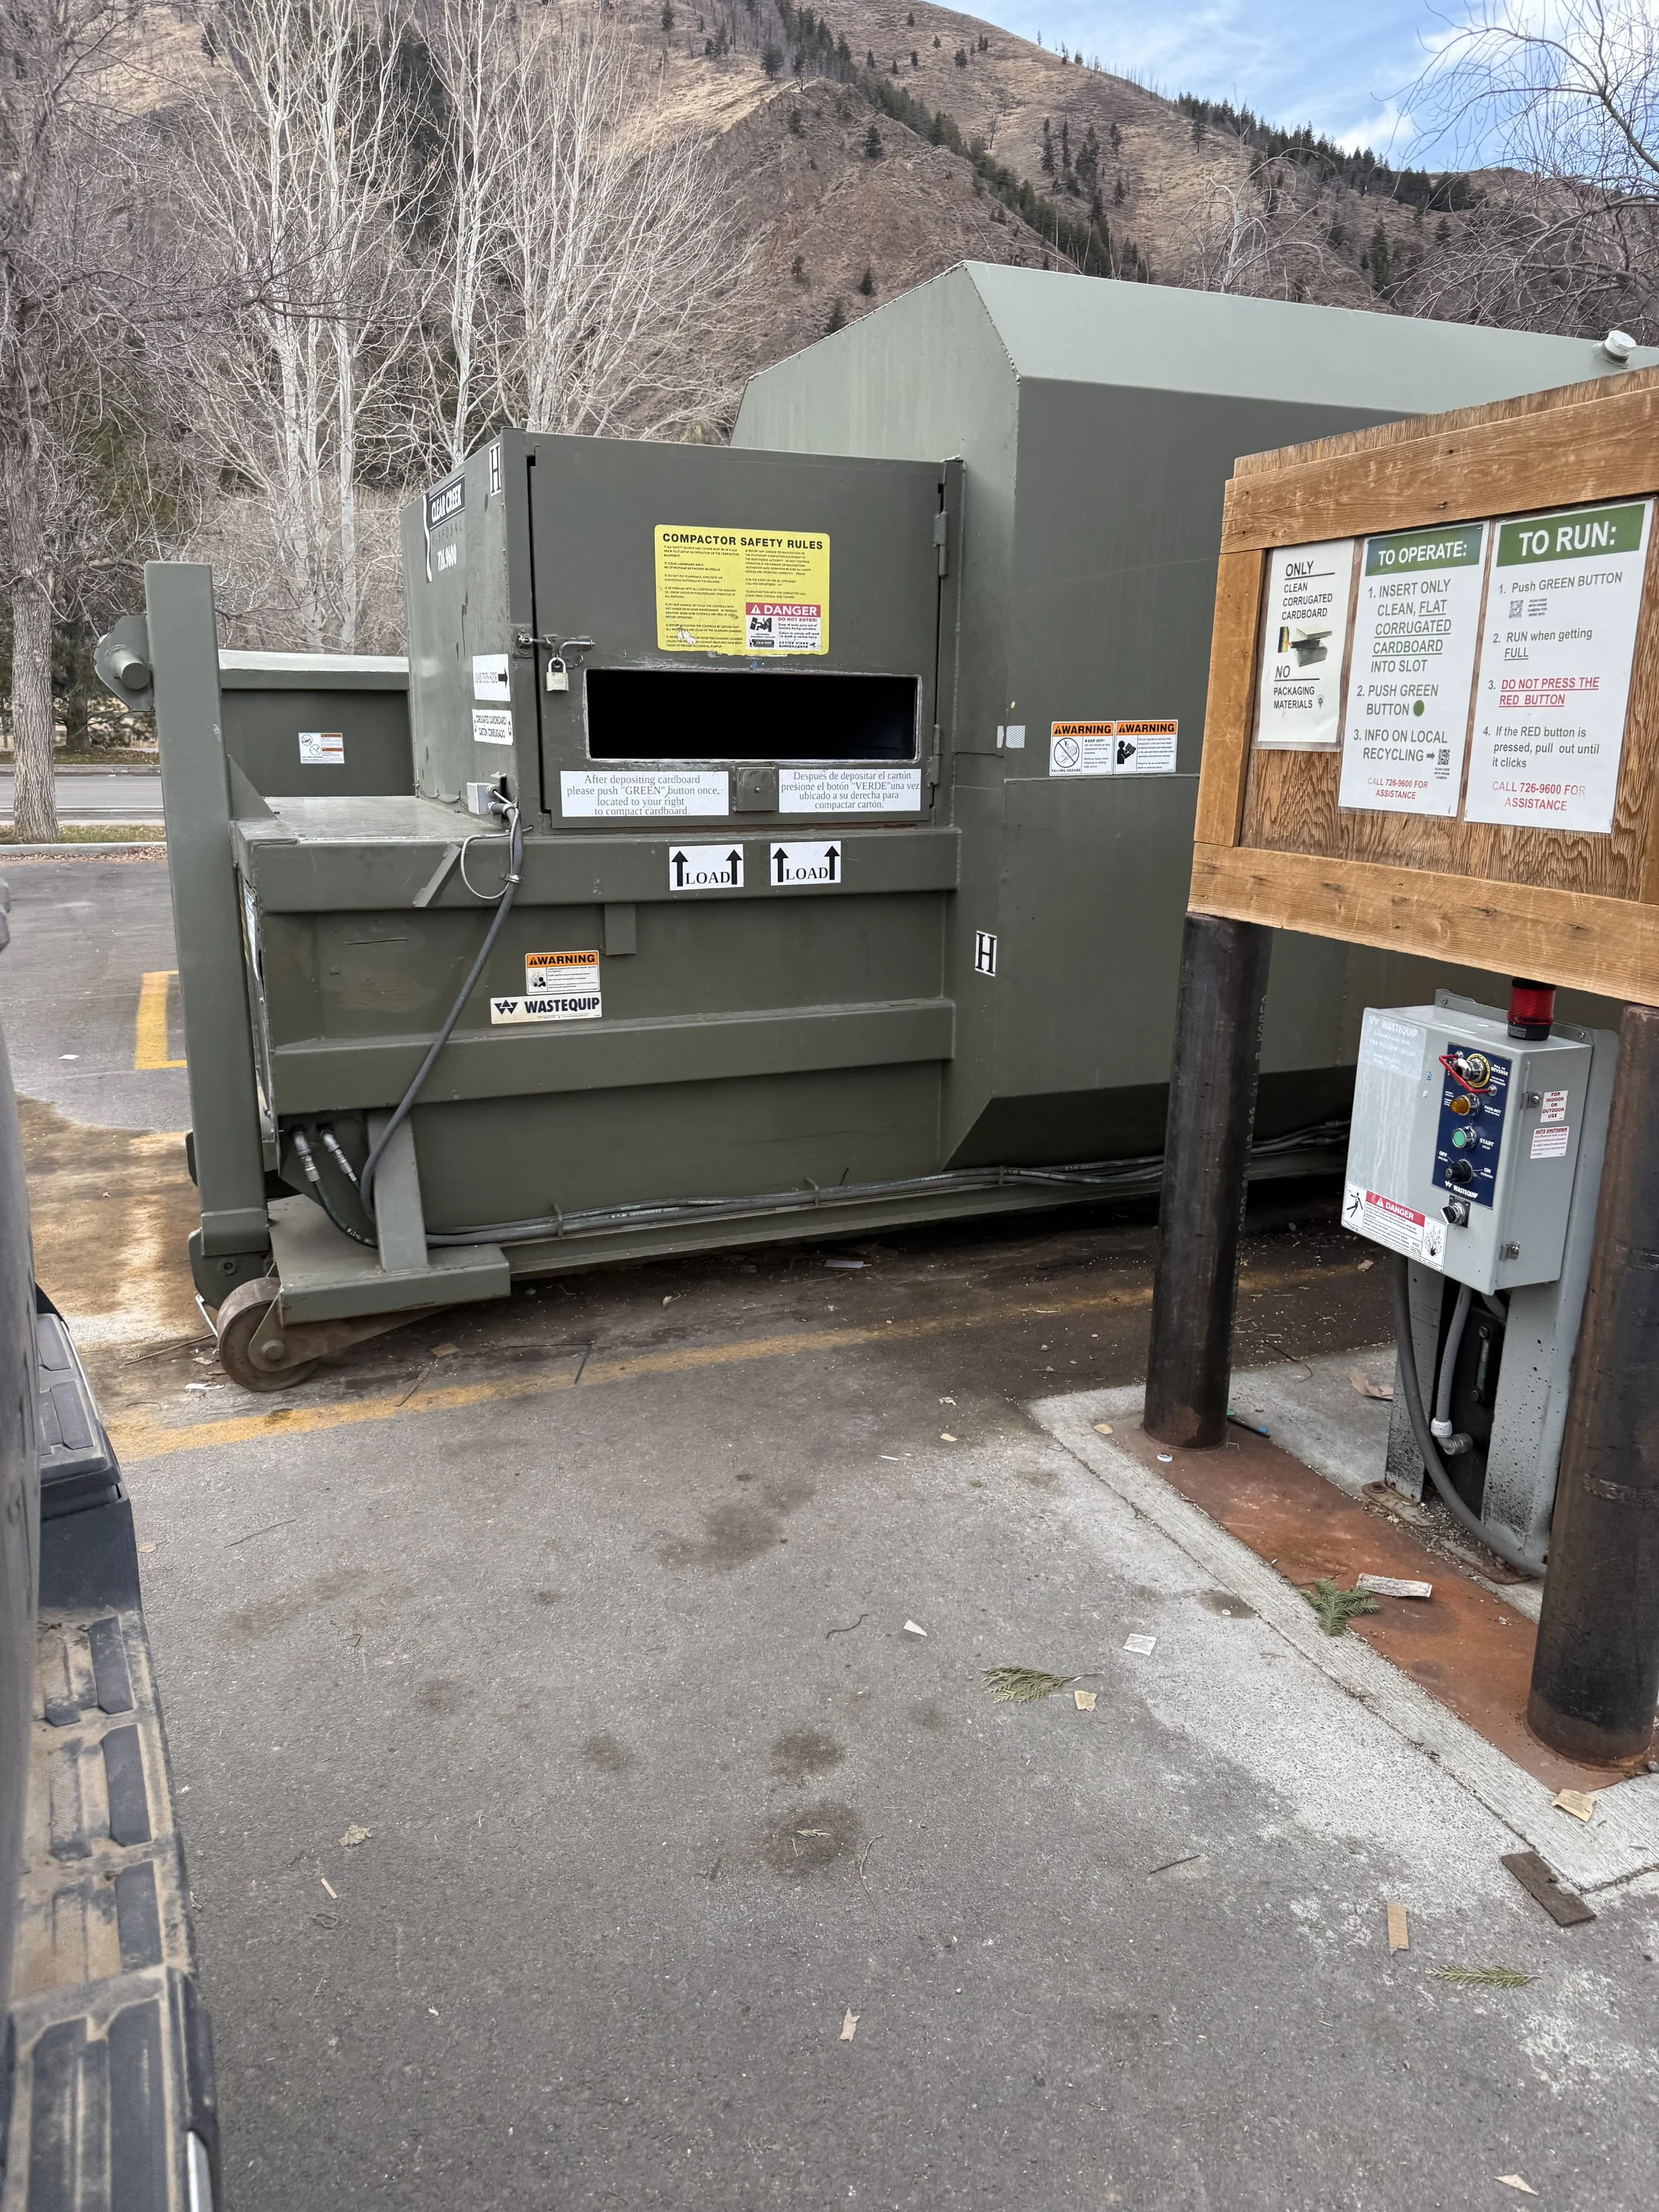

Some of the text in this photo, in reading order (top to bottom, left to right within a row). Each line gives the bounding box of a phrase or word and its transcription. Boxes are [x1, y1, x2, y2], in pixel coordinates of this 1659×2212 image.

[490, 445, 501, 493] H
[431, 483, 462, 523] CLEAR CREEK
[662, 533, 823, 550] COMPACTOR SAFETY RULES
[1519, 521, 1617, 556] TO RUN:
[1378, 541, 1467, 565] TO OPERATE:
[1285, 561, 1314, 576] ONLY
[1284, 582, 1308, 593] CLEAN
[1368, 579, 1451, 598] 1. INSERT ONLY
[1499, 571, 1623, 594] 1. Push GREEN BUTTON
[1283, 593, 1333, 607] CORRUGATED
[764, 605, 817, 616] DANGER
[1281, 608, 1328, 620] CARDBOARD
[1378, 599, 1447, 616] CLEAN, FLAT
[1376, 619, 1451, 635] CORRUGATED
[1493, 628, 1593, 643] 2. RUN when getting
[1373, 639, 1443, 654] CARDBOARD
[1504, 647, 1529, 658] FULL
[1275, 665, 1290, 678] NO
[1371, 660, 1428, 673] INTO SLOT
[1356, 684, 1439, 696] 2. PUSH GREEN
[1488, 677, 1600, 690] 3. DO NOT PRESS THE
[1274, 686, 1315, 696] PACKAGING
[1273, 700, 1313, 709] MATERIALS
[1499, 694, 1565, 705] RED BUTTON
[1366, 703, 1409, 715] BUTTON
[1062, 725, 1112, 734] WARNING
[1125, 723, 1175, 733] WARNING
[1483, 726, 1586, 737] 4. If the RED button is
[1354, 729, 1448, 743] 3. INFO ON LOCAL
[1363, 747, 1424, 761] RECYCLING
[1494, 742, 1600, 755] pressed, pull out until
[1492, 757, 1527, 768] it clicks
[584, 774, 700, 786] After depositing cardboard
[829, 771, 838, 780] de
[841, 771, 876, 782] depositar
[878, 771, 885, 780] el
[1368, 777, 1384, 786] CALL
[1386, 779, 1413, 788] 726-9600
[567, 786, 595, 797] please
[597, 786, 618, 797] push
[620, 786, 666, 794] "GREEN"
[781, 782, 815, 792] presione
[817, 782, 824, 790] el
[827, 782, 849, 790] botón
[1492, 781, 1586, 796] CALL 726-9600 FOR
[851, 791, 881, 800] derecha
[883, 792, 899, 801] para
[1376, 790, 1416, 800] ASSISTANCE
[597, 797, 628, 806] located
[642, 799, 662, 808] your
[664, 797, 684, 808] right
[815, 801, 855, 810] compactar
[1504, 797, 1567, 811] ASSISTANCE
[645, 806, 690, 815] cardboard.
[685, 871, 730, 885] LOAD
[786, 867, 828, 880] LOAD
[537, 954, 595, 965] WARNING
[975, 932, 996, 974] H
[524, 997, 600, 1013] WASTEQUIP
[1382, 1019, 1417, 1037] WASTEQUIP
[1491, 1067, 1508, 1076] REVERSE
[1480, 1138, 1494, 1147] START
[1453, 1185, 1479, 1199] WASTEQUIP
[1385, 1202, 1414, 1220] DANGER
